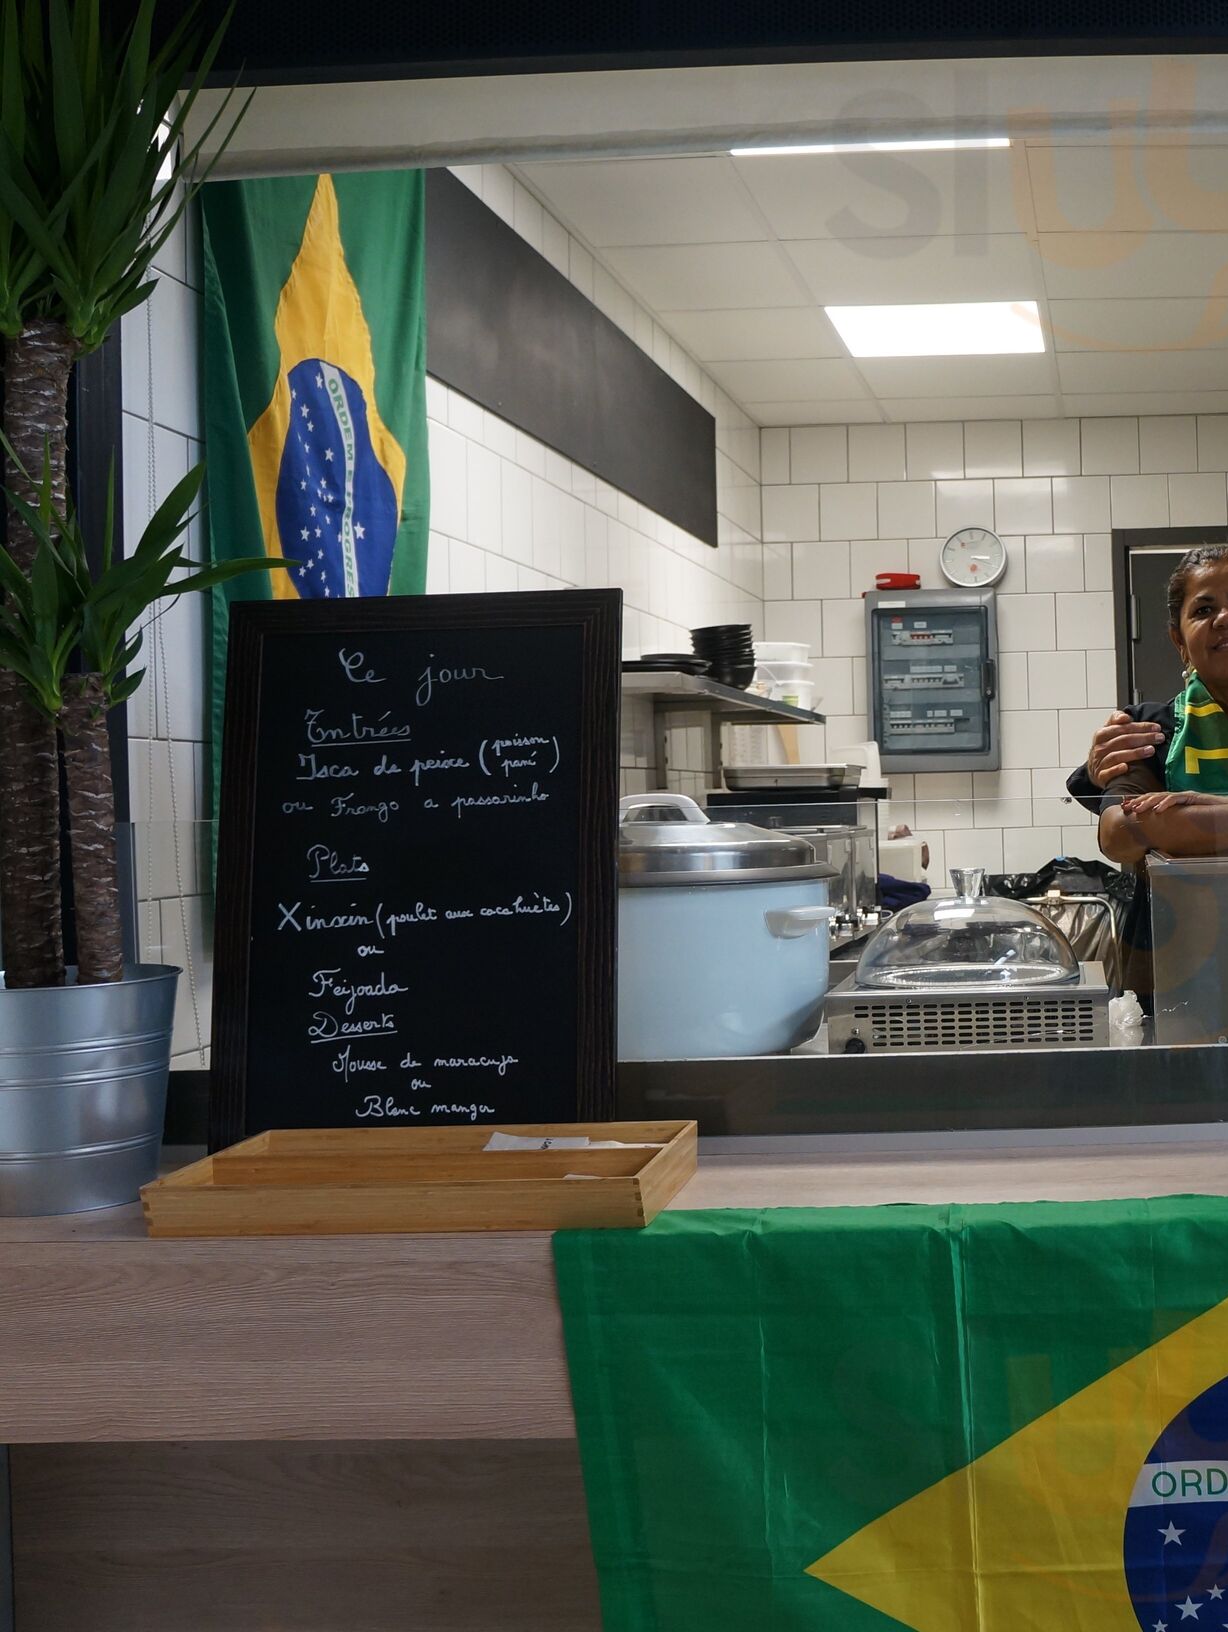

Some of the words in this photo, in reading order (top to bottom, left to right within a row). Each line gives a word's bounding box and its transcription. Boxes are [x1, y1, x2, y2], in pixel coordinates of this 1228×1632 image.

[416, 654, 503, 705] jour
[282, 801, 313, 815] ou
[308, 845, 369, 881] Plats
[358, 946, 384, 956] ou
[309, 1011, 397, 1043] Desserts
[400, 1053, 421, 1068] de
[411, 1079, 431, 1090] ou
